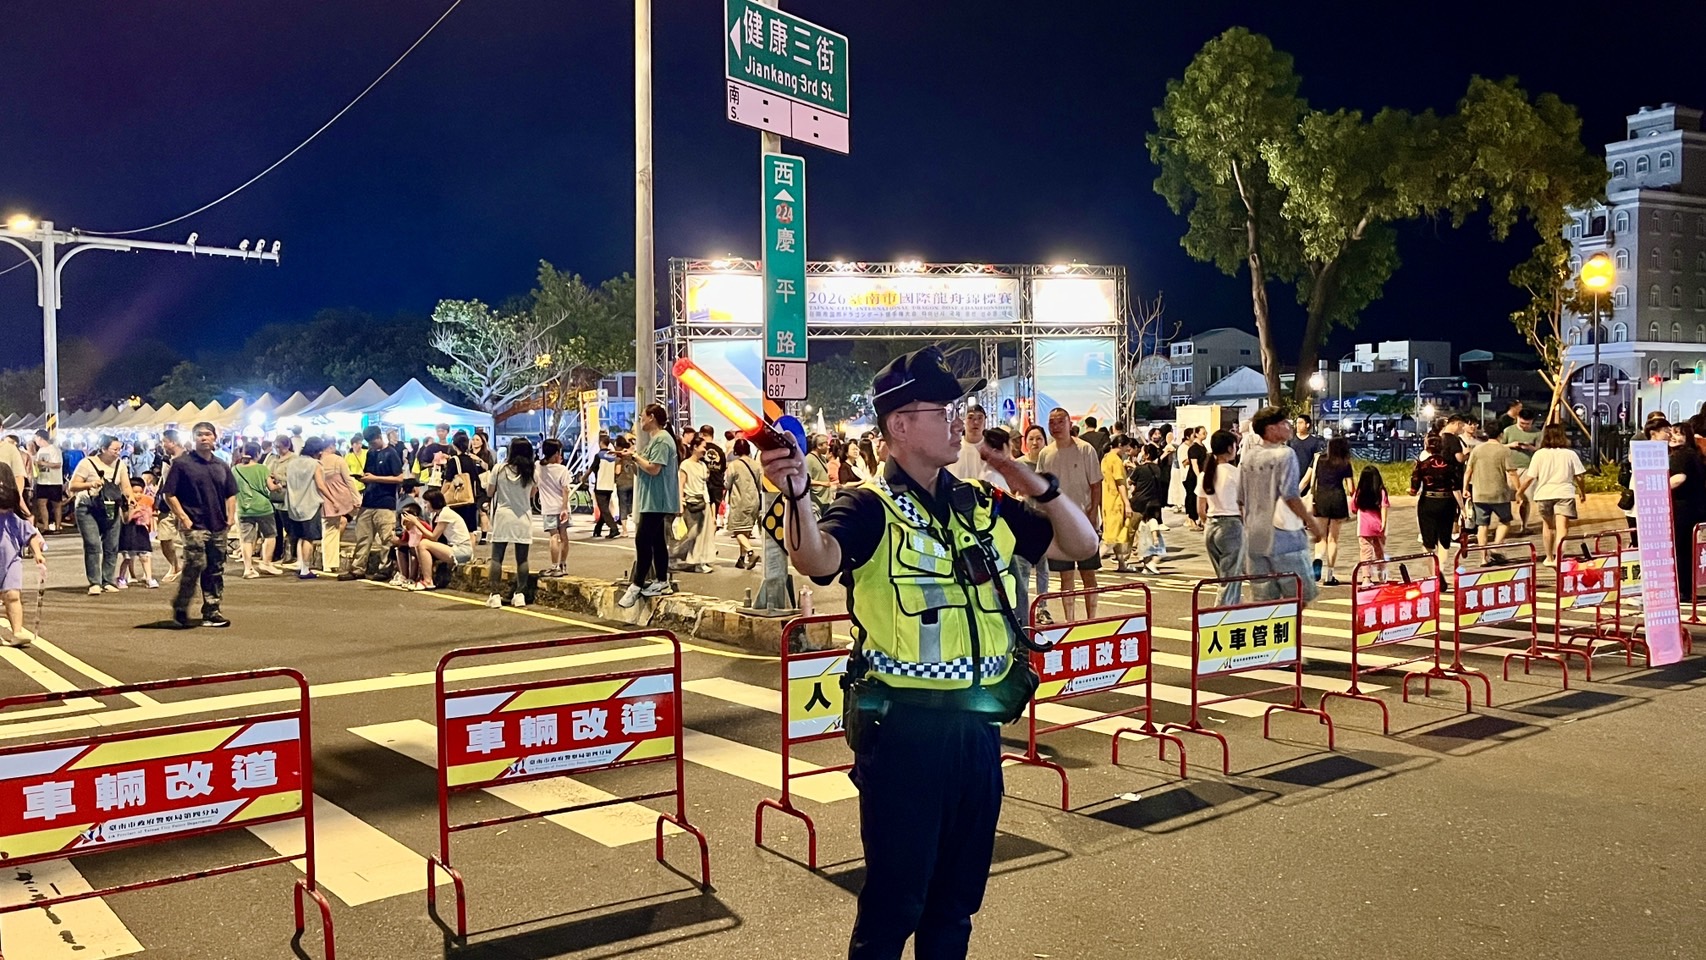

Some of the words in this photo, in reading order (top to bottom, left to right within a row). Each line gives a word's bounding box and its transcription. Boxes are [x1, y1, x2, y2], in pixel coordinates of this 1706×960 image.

[743, 5, 835, 74] 健康三街
[729, 85, 740, 105] 南
[745, 55, 798, 94] Jiankang
[799, 73, 818, 96] 3rd
[821, 81, 835, 102] St.
[731, 106, 739, 120] S.
[773, 160, 794, 187] 西
[775, 227, 797, 355] 慶平路
[768, 364, 786, 376] 687
[768, 384, 786, 397] 687
[1208, 621, 1289, 654] 人車管制
[1043, 637, 1139, 675] 車輛改道
[466, 701, 657, 754] 車輛改道
[23, 750, 279, 820] 車輛改道
